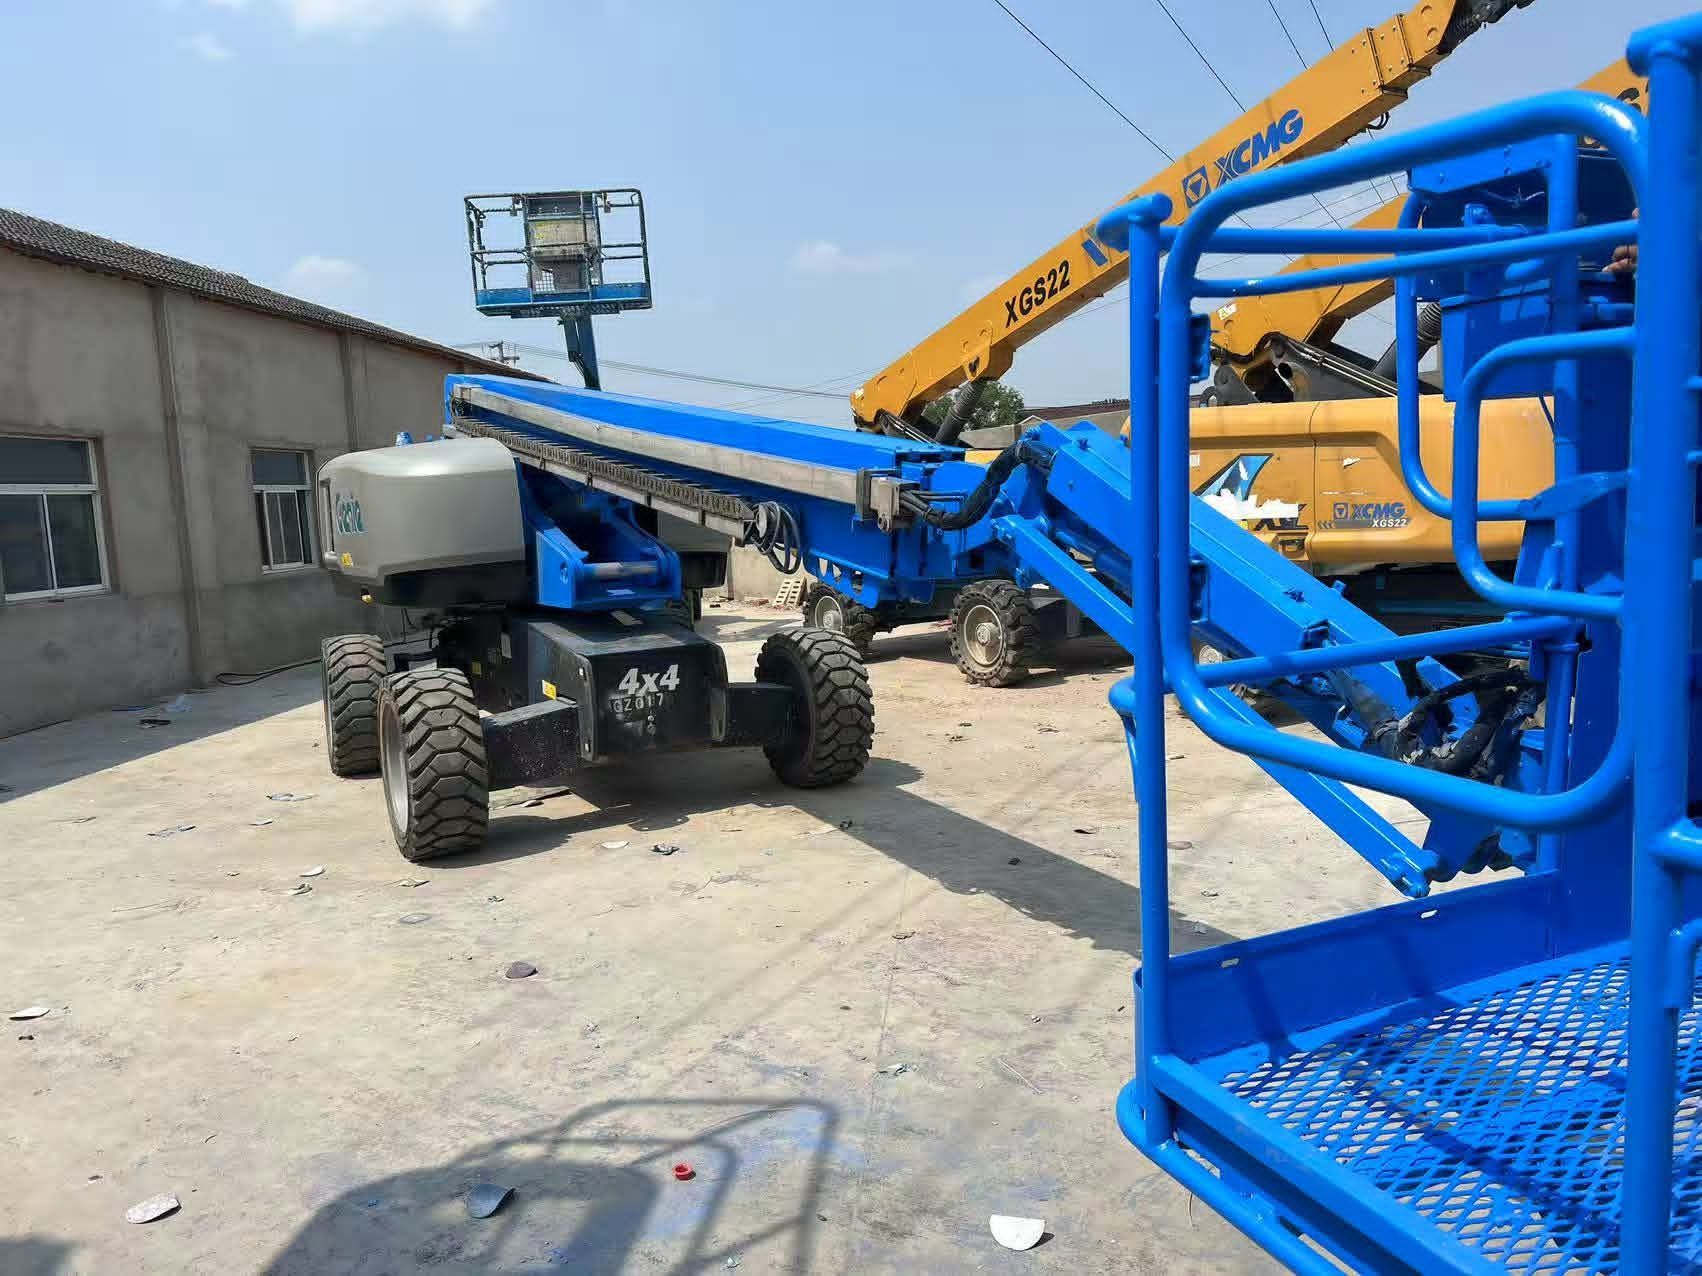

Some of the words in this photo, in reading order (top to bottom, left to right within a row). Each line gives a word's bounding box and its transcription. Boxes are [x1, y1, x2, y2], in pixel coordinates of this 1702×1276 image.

[1213, 108, 1304, 190] XCMG
[1004, 259, 1071, 328] XGS22
[1352, 502, 1407, 520] XCMG
[1371, 518, 1408, 528] XGS22
[618, 663, 680, 696] 4x4
